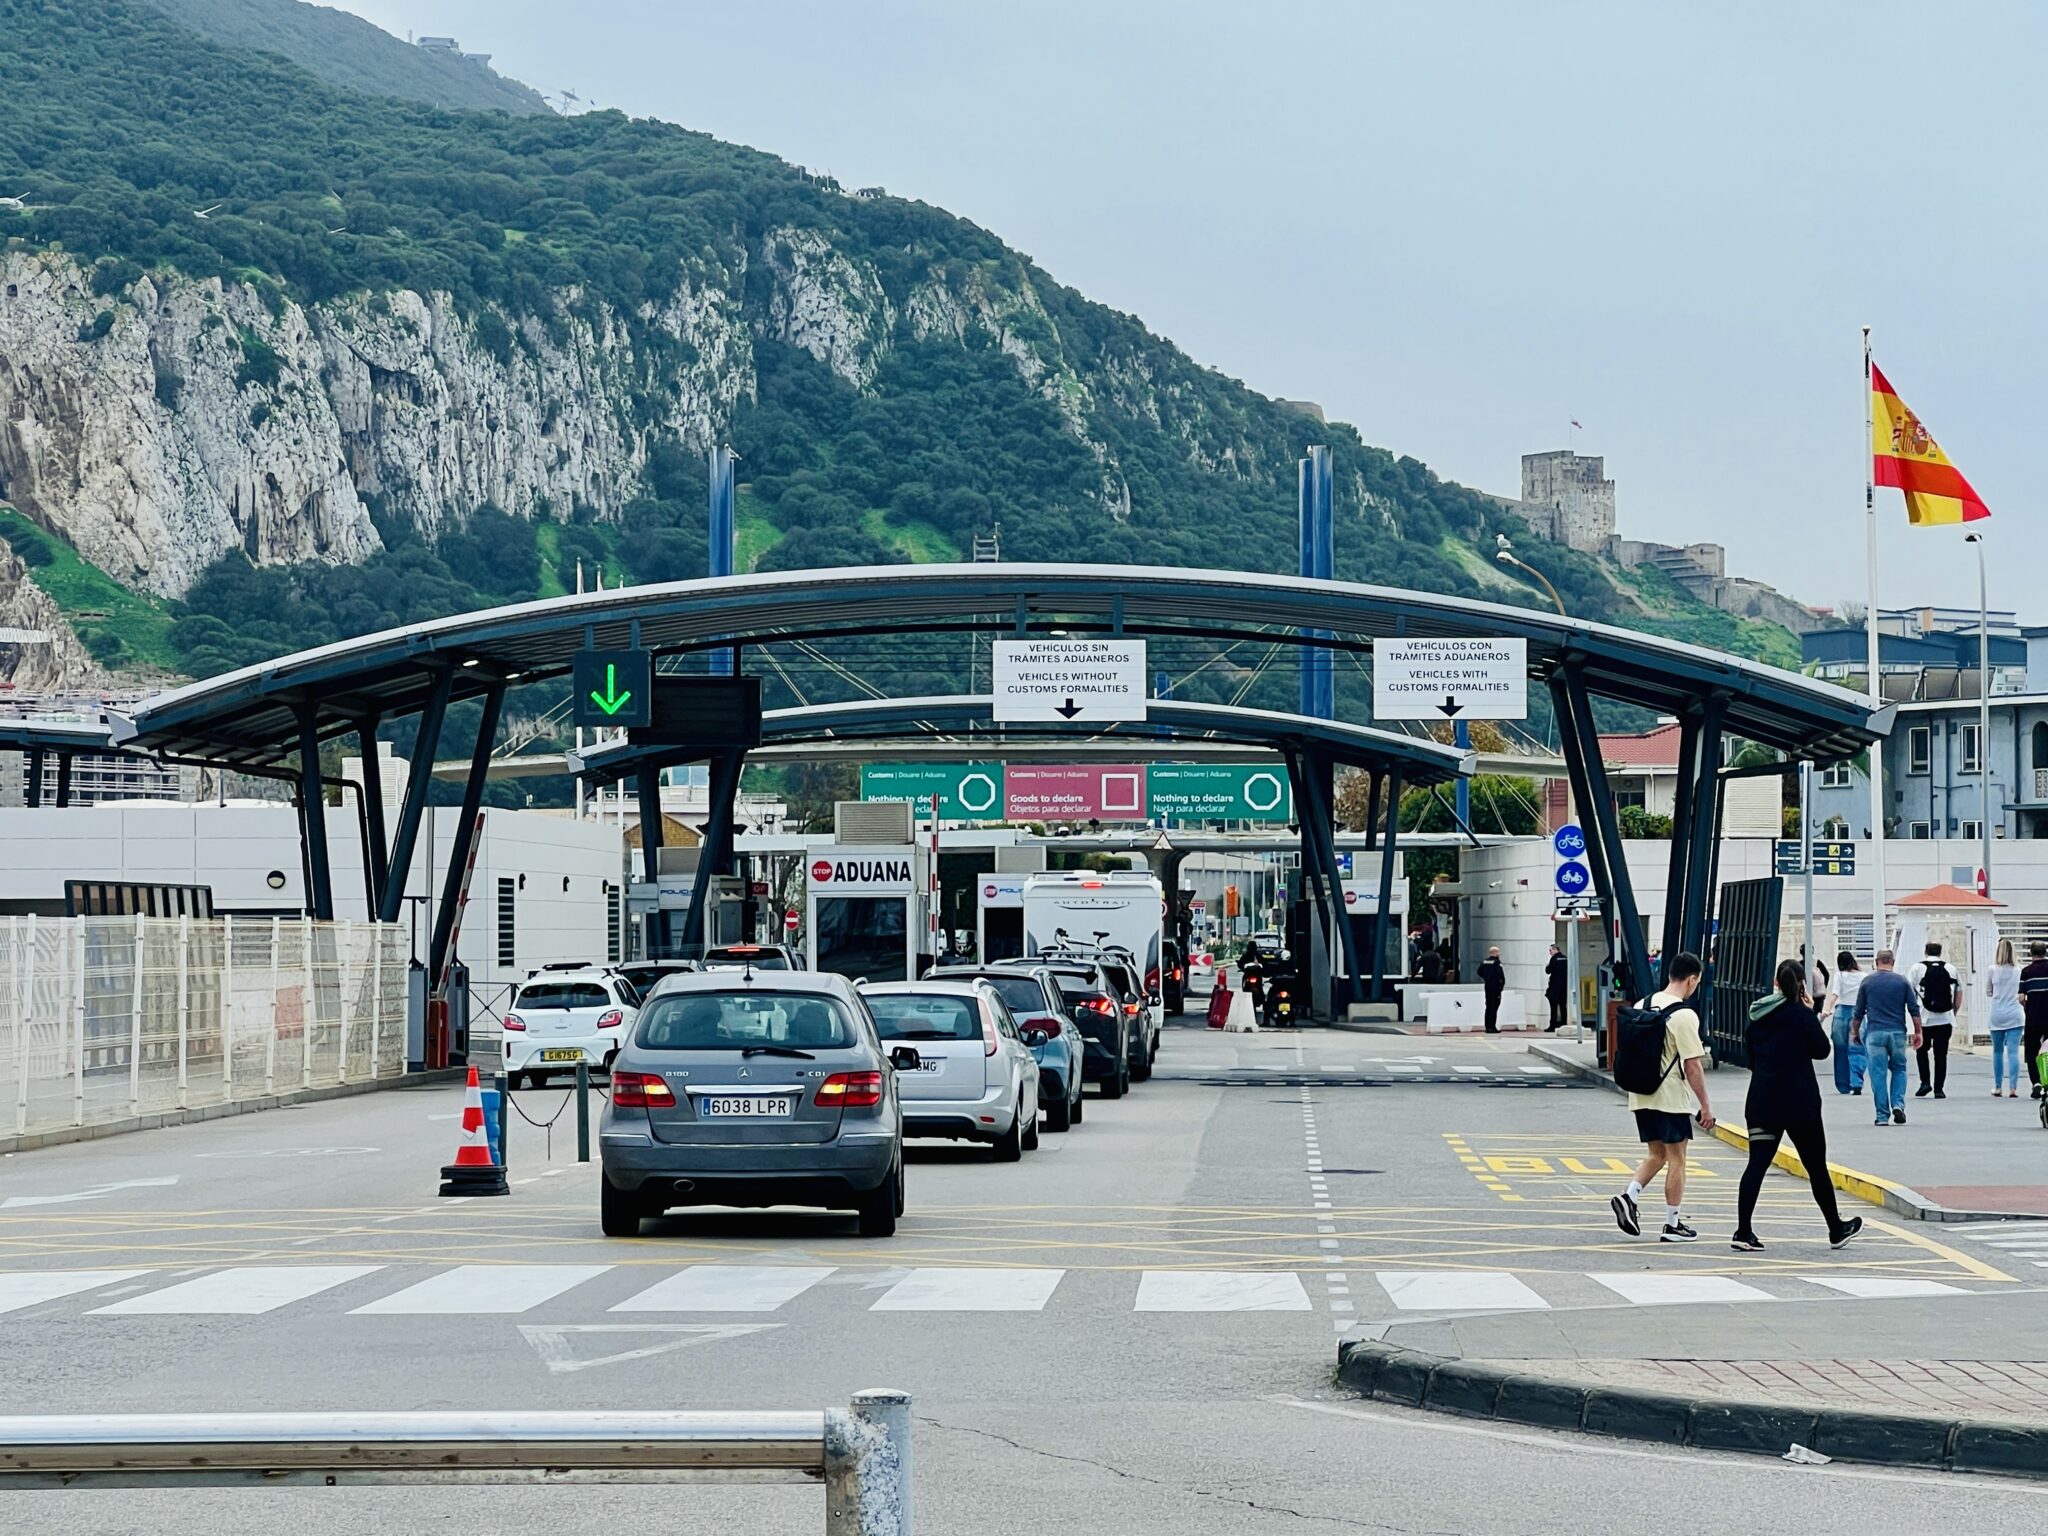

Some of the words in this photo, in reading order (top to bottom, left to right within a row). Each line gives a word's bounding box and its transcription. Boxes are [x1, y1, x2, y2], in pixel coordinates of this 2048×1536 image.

[1029, 643, 1088, 652] VEHÍCULOS
[1092, 644, 1109, 652] SIN
[1407, 641, 1466, 650] VEHÍCULOS
[1470, 642, 1492, 650] CON
[1008, 654, 1060, 663] TRÁMITES
[1063, 655, 1129, 663] ADUANEROS
[1389, 652, 1441, 661] TRÁMITES
[1444, 652, 1510, 661] ADUANEROS
[1018, 672, 1069, 681] VEHICLES
[1071, 672, 1118, 681] WITHOUT
[1409, 670, 1459, 679] VEHICLES
[1462, 670, 1488, 679] WITH
[1007, 685, 1057, 693] CUSTOMS
[1060, 684, 1129, 693] FORMALITIES
[1388, 683, 1438, 691] CUSTOMS
[1441, 683, 1509, 691] FORMALITIES
[905, 795, 915, 803] to
[917, 795, 948, 803] decre
[1010, 794, 1038, 803] Goods
[1040, 795, 1050, 803] to
[1052, 794, 1084, 803] declare
[1153, 794, 1188, 804] Nothing
[1191, 795, 1201, 803] to
[1202, 794, 1234, 803] declare
[1010, 805, 1040, 814] Objetos
[1042, 806, 1060, 814] para
[1061, 805, 1092, 813] declarar
[1153, 805, 1174, 813] Nada
[1176, 806, 1193, 814] para
[1195, 805, 1226, 813] declarar
[834, 861, 912, 882] ADUANA
[711, 1099, 751, 1114] 6038
[757, 1099, 787, 1114] LPR
